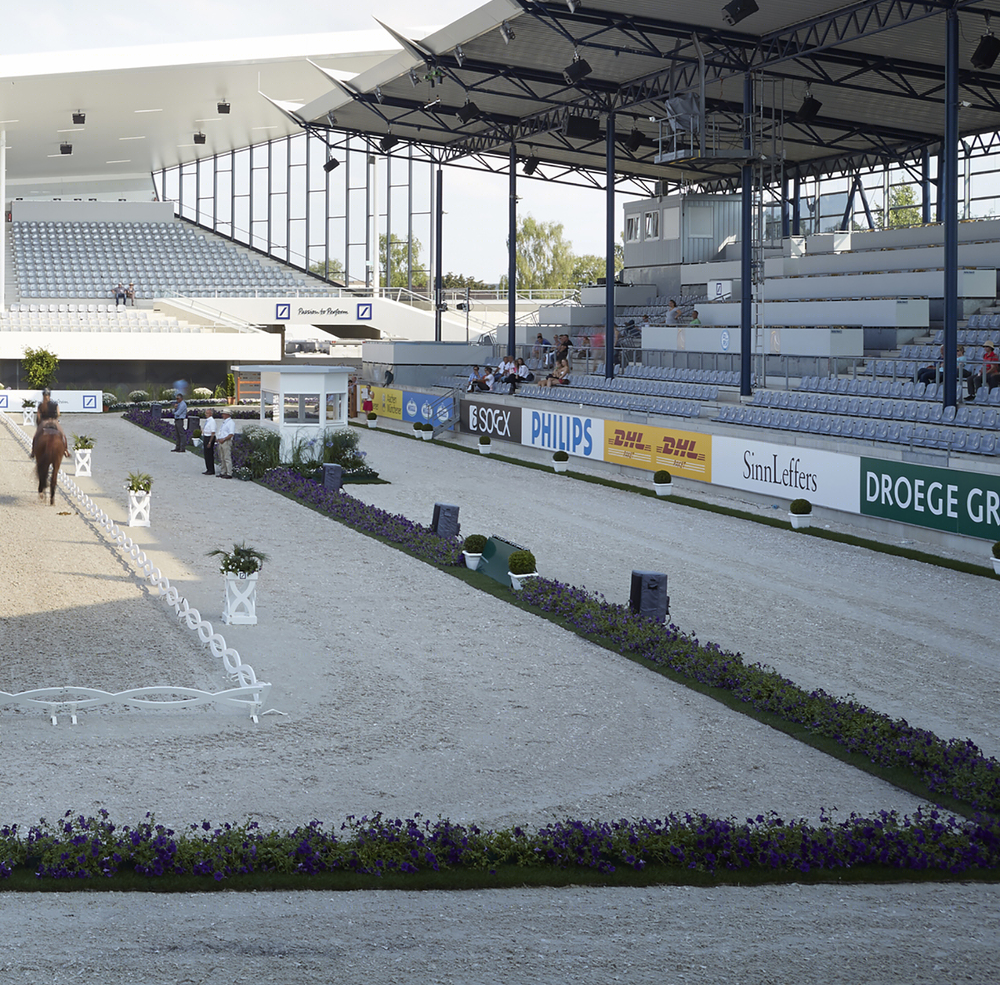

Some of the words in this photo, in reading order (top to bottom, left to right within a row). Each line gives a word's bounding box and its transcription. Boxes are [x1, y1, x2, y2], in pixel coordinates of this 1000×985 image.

[532, 411, 593, 456] PHILIPS
[614, 429, 645, 450] DHL
[662, 436, 698, 459] DHL
[743, 450, 818, 492] SinnLeffers
[866, 471, 958, 518] DROEGE
